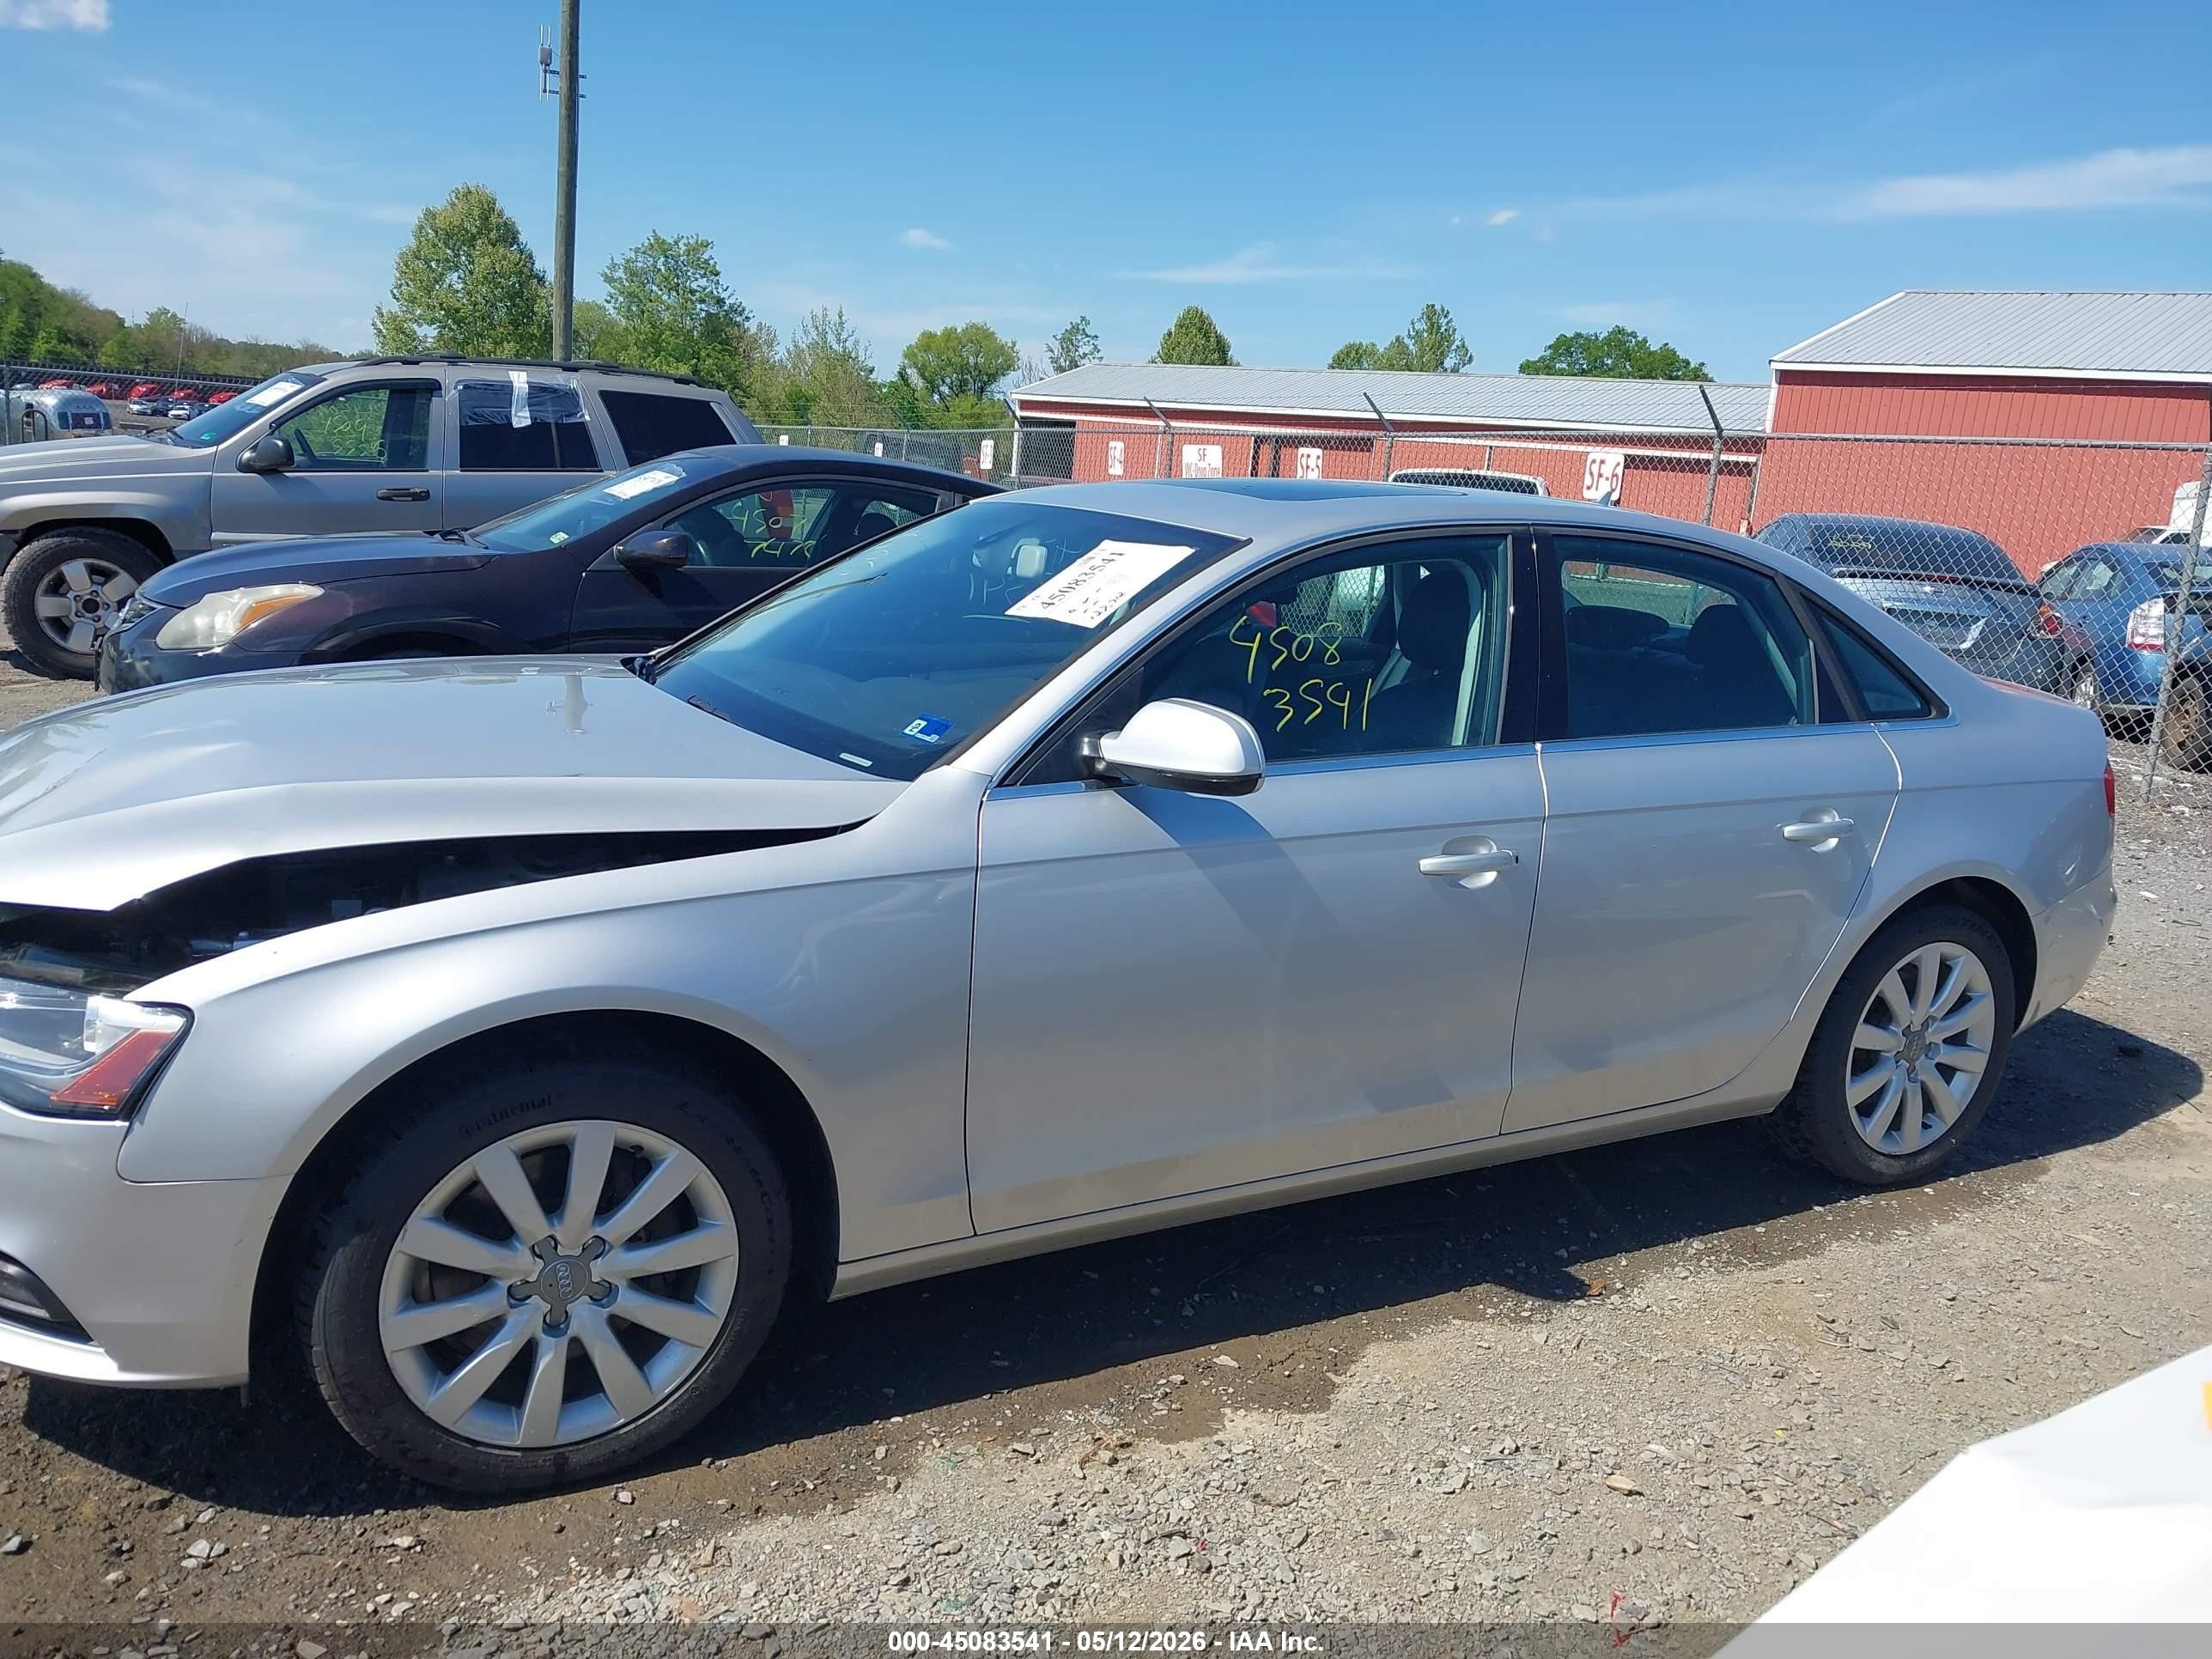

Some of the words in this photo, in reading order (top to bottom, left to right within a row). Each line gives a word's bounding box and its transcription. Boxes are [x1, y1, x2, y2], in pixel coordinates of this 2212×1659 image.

[1197, 447, 1207, 462] SF
[1299, 453, 1321, 480] SF-5
[1586, 459, 1621, 493] SF-6
[1041, 551, 1126, 610] 45083541
[1229, 615, 1342, 684] 4508
